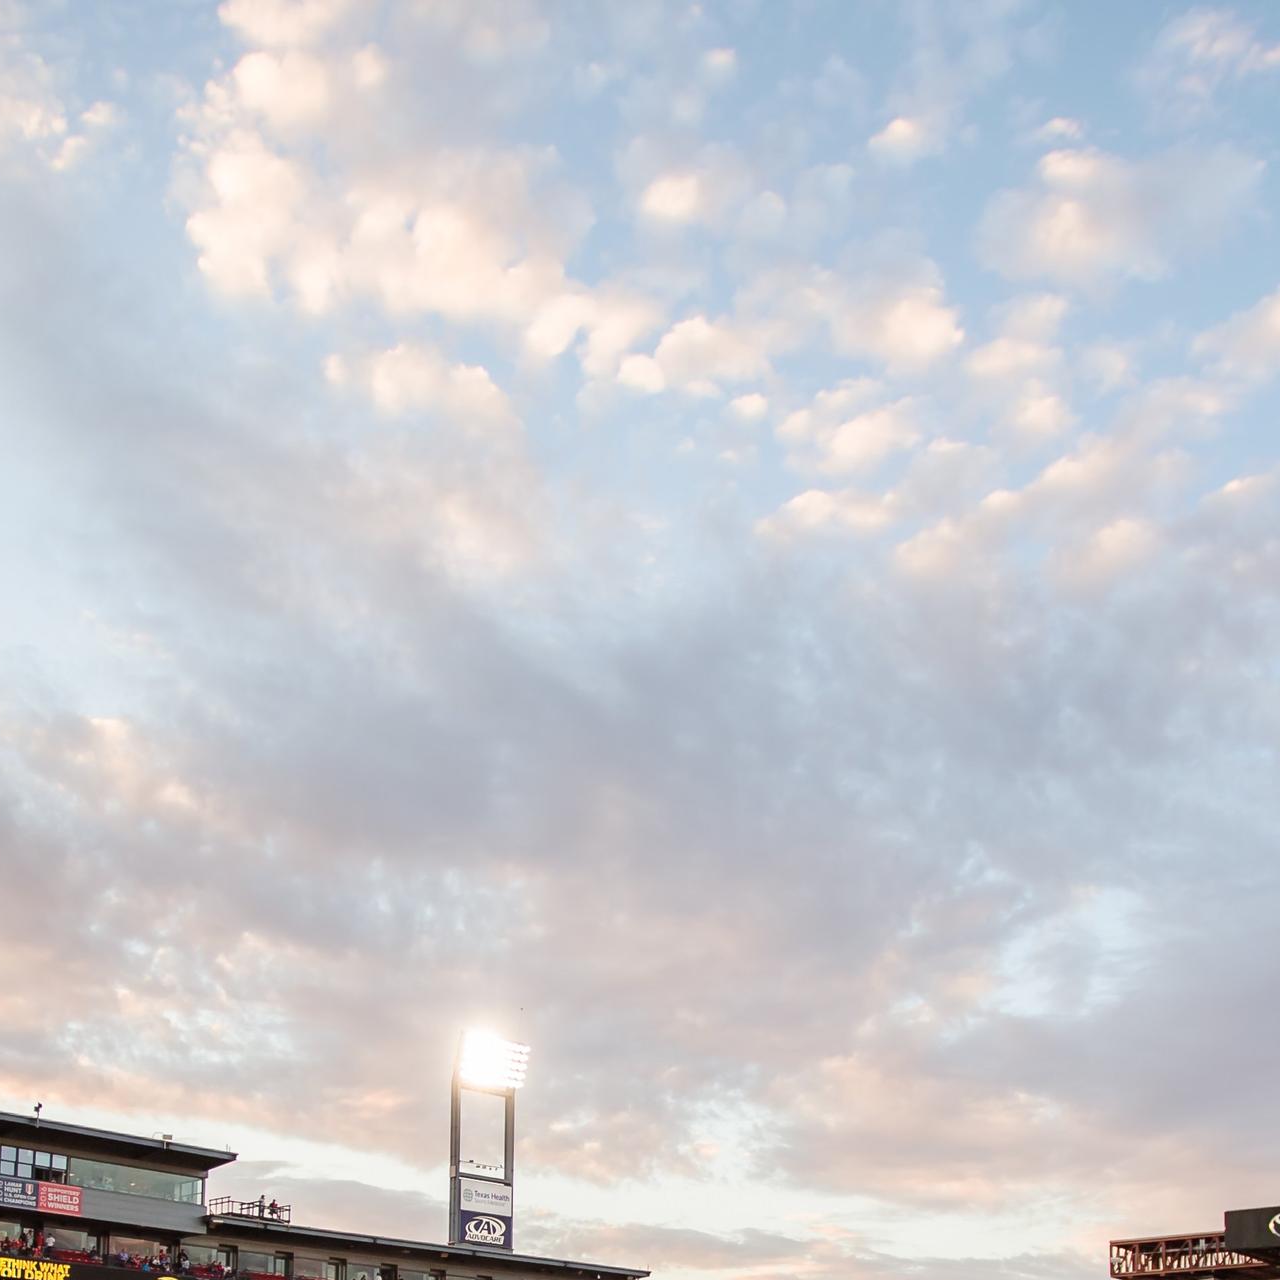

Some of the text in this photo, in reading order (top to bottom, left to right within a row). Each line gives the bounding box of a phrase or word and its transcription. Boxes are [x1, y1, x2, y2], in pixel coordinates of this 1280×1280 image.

[48, 1193, 79, 1204] SHIELD
[475, 1190, 510, 1202] Texas Health
[4, 1198, 36, 1207] CHAMPIONS
[48, 1202, 79, 1212] WINNERS
[466, 1233, 504, 1244] ADVOCARE
[39, 1261, 70, 1274] WHAT
